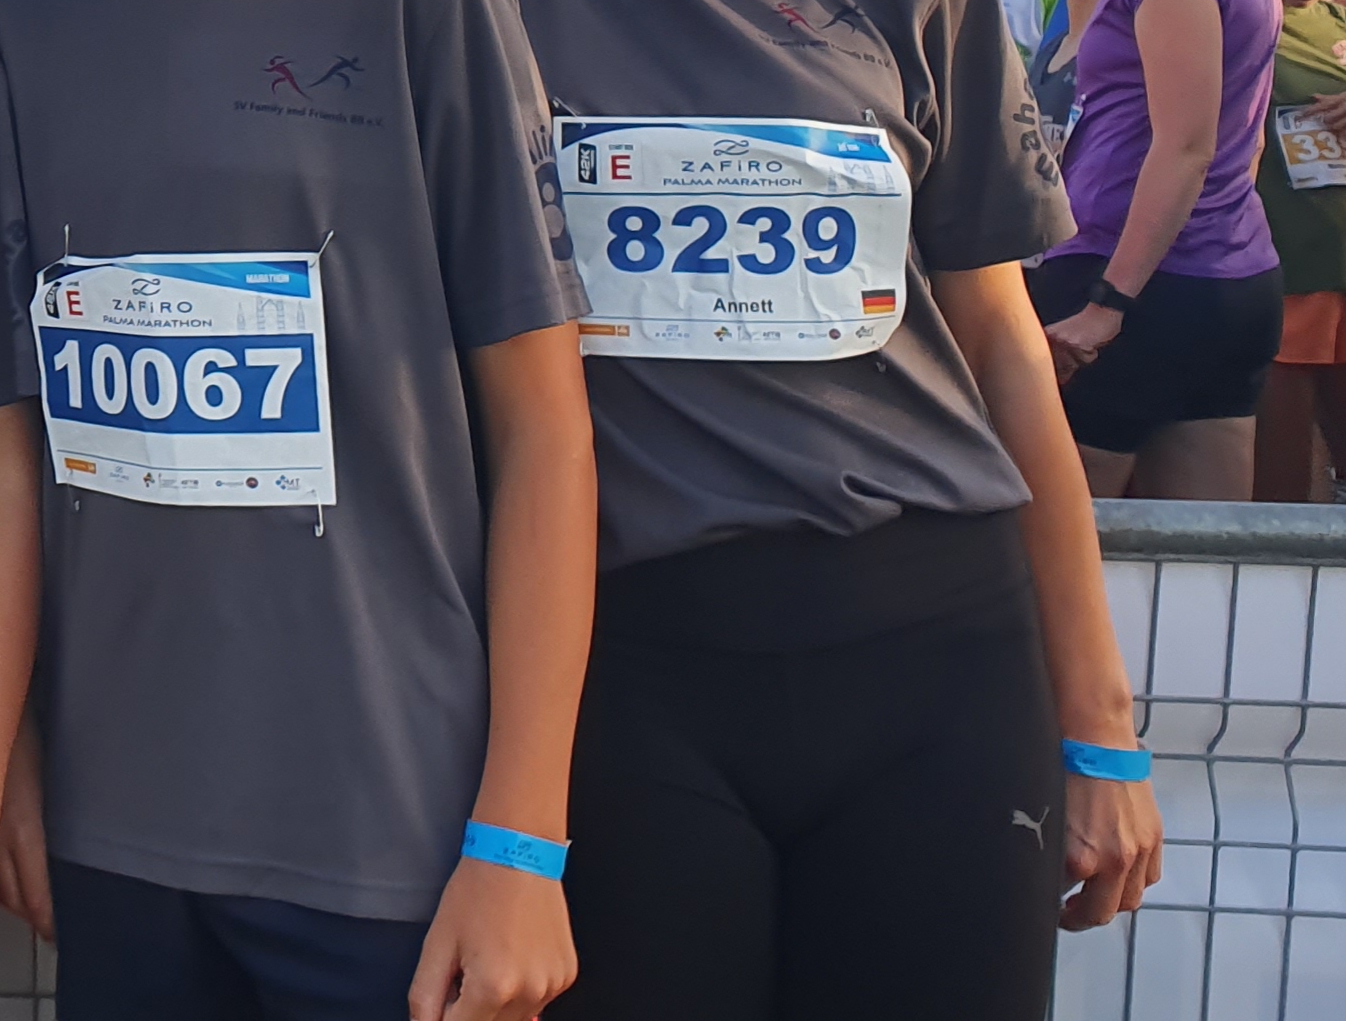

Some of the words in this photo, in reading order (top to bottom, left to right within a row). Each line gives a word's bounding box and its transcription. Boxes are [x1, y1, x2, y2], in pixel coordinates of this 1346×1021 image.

[611, 155, 632, 180] E
[663, 178, 713, 187] PALMA
[717, 178, 802, 187] MARATHON
[606, 205, 857, 275] 8239
[66, 290, 83, 316] E
[712, 297, 774, 314] Annett
[103, 315, 136, 326] PALMA
[137, 318, 212, 328] MARATHON
[54, 340, 303, 420] 10067
